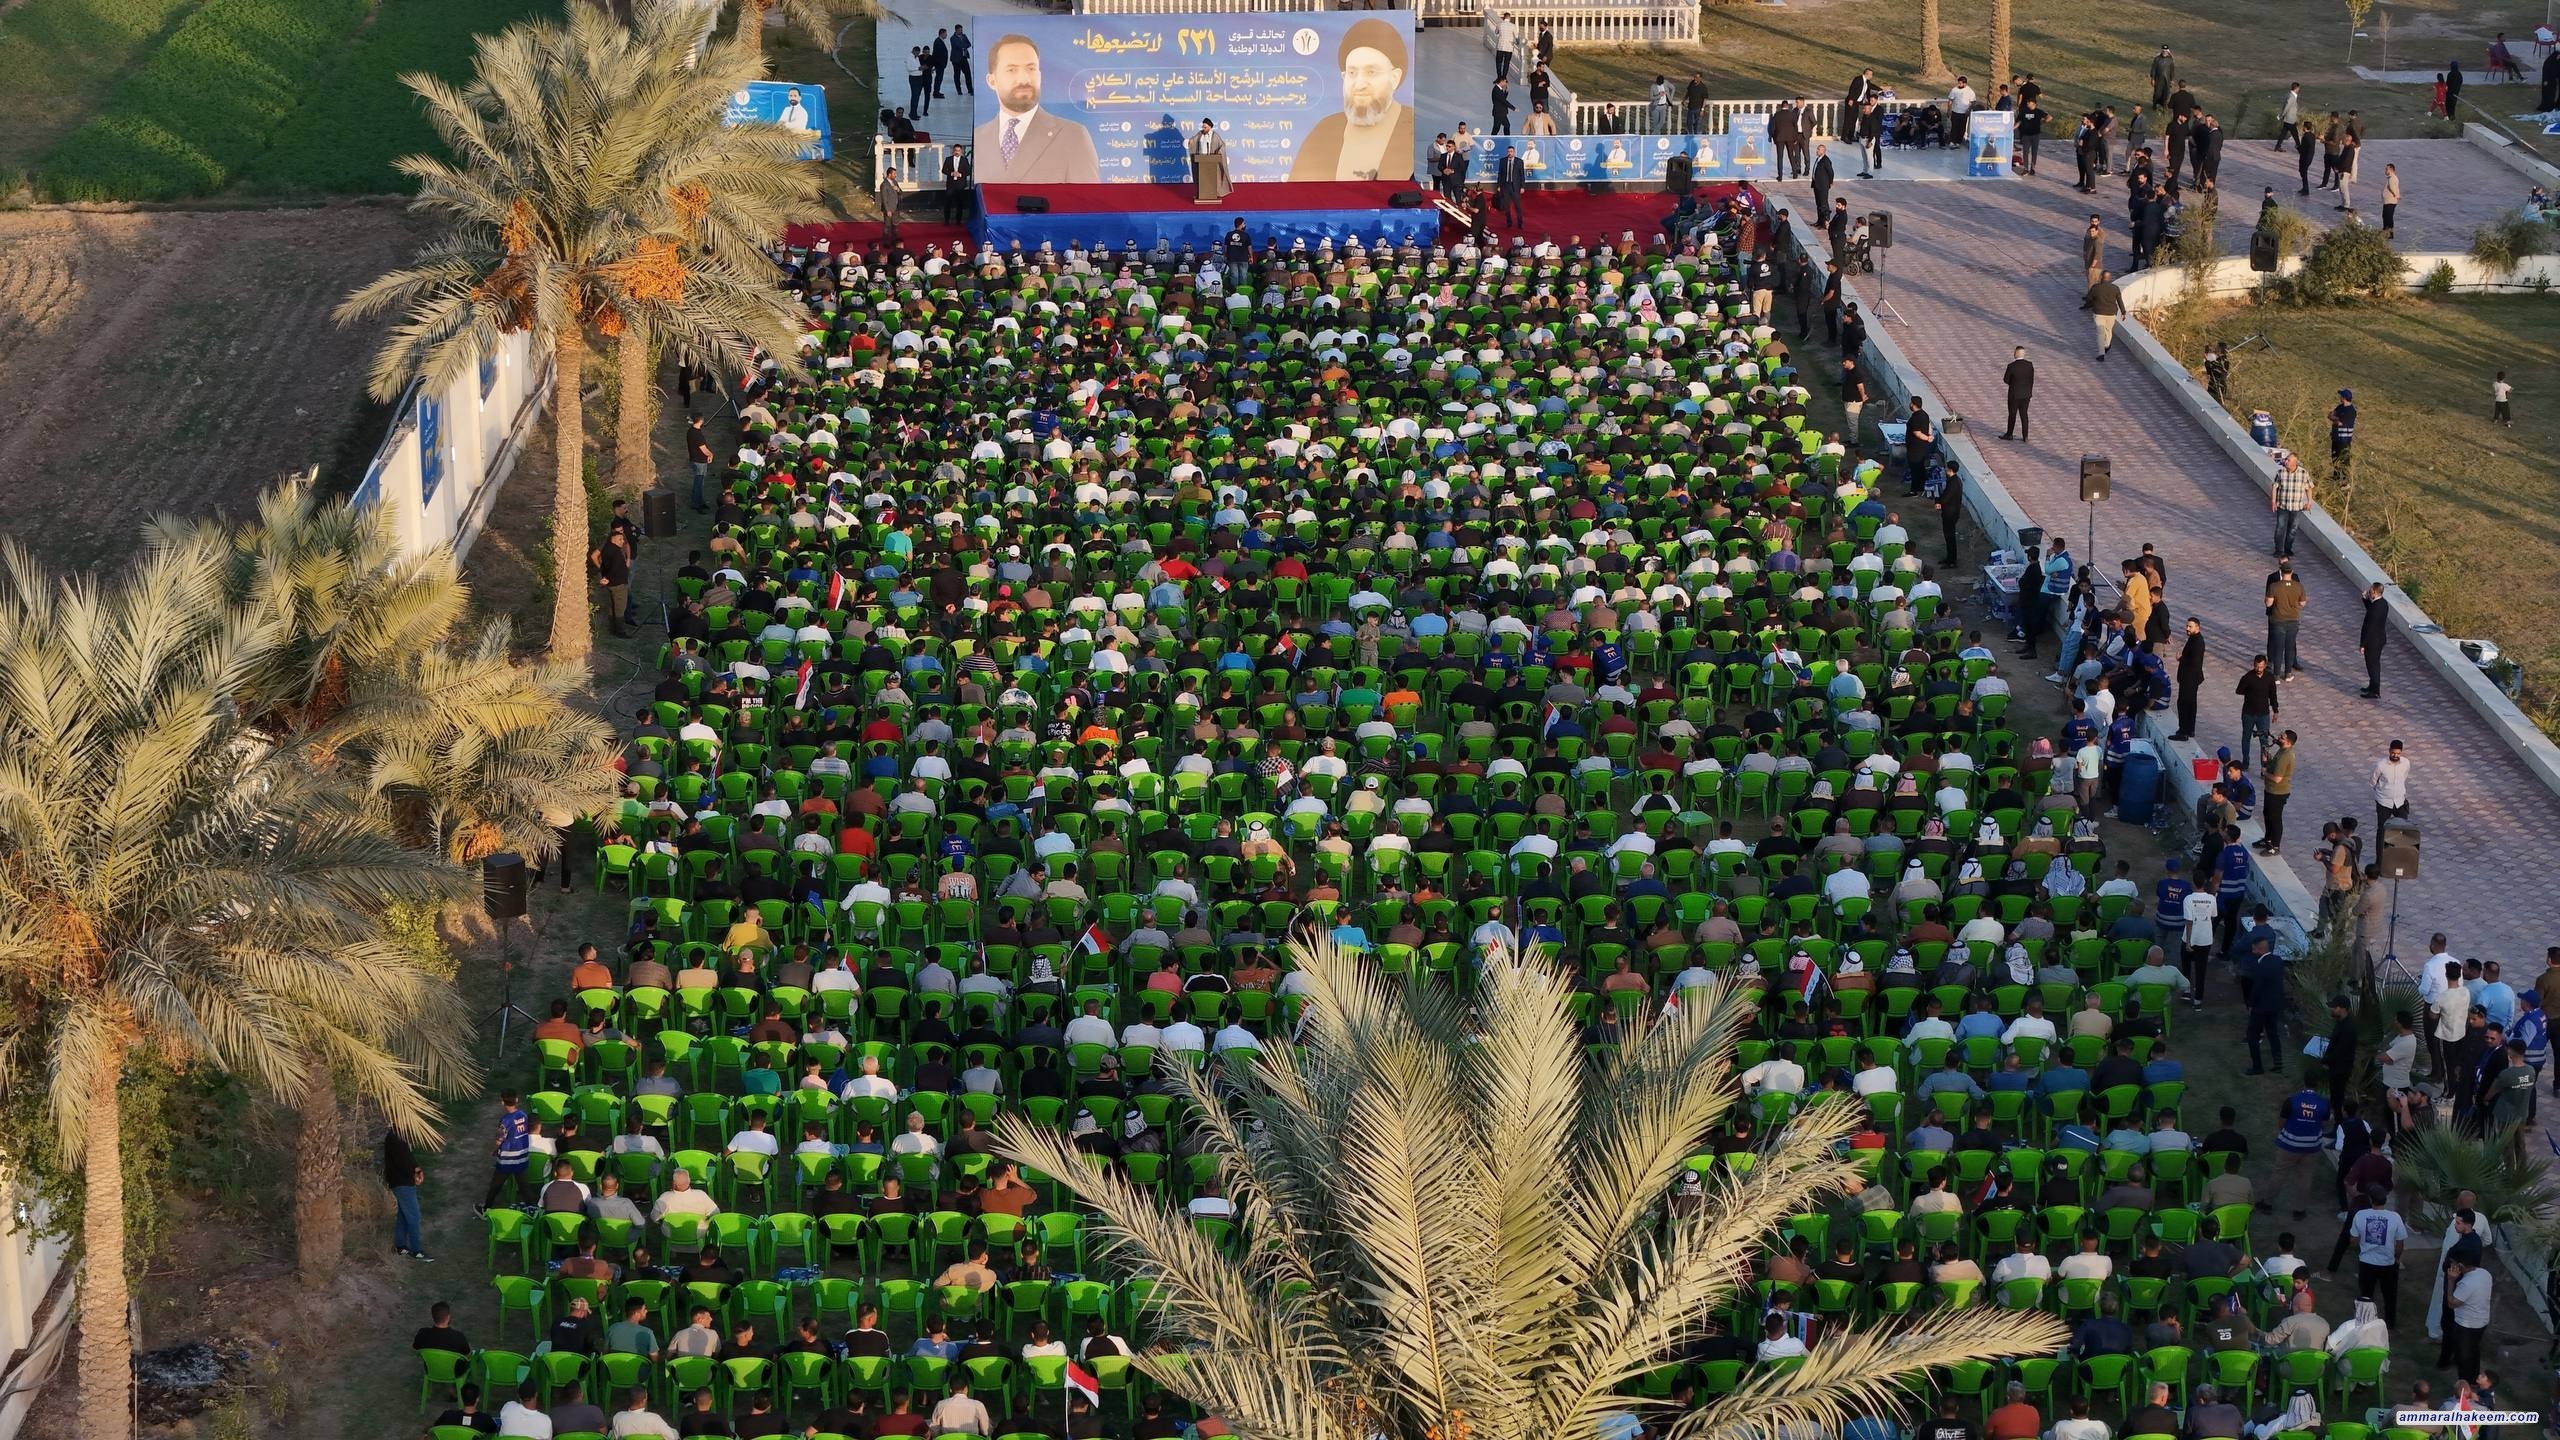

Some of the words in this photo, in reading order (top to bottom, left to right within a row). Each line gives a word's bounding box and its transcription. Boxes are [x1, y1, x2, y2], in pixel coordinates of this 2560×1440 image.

[1177, 28, 1216, 56] ٢٣١
[1228, 28, 1254, 42] قوى
[1256, 29, 1286, 40] تحالف
[1228, 43, 1258, 56] الوطنية
[1260, 43, 1286, 56] الدولة
[1135, 73, 1160, 89] نجم
[1162, 71, 1185, 91] علي
[1188, 69, 1226, 85] الأستاذ
[1265, 71, 1308, 88] جماهير
[1086, 90, 1156, 110] الحكيم
[1159, 88, 1202, 107] السيد
[1206, 88, 1253, 106] بسماحة
[1255, 92, 1307, 106] يرحبون
